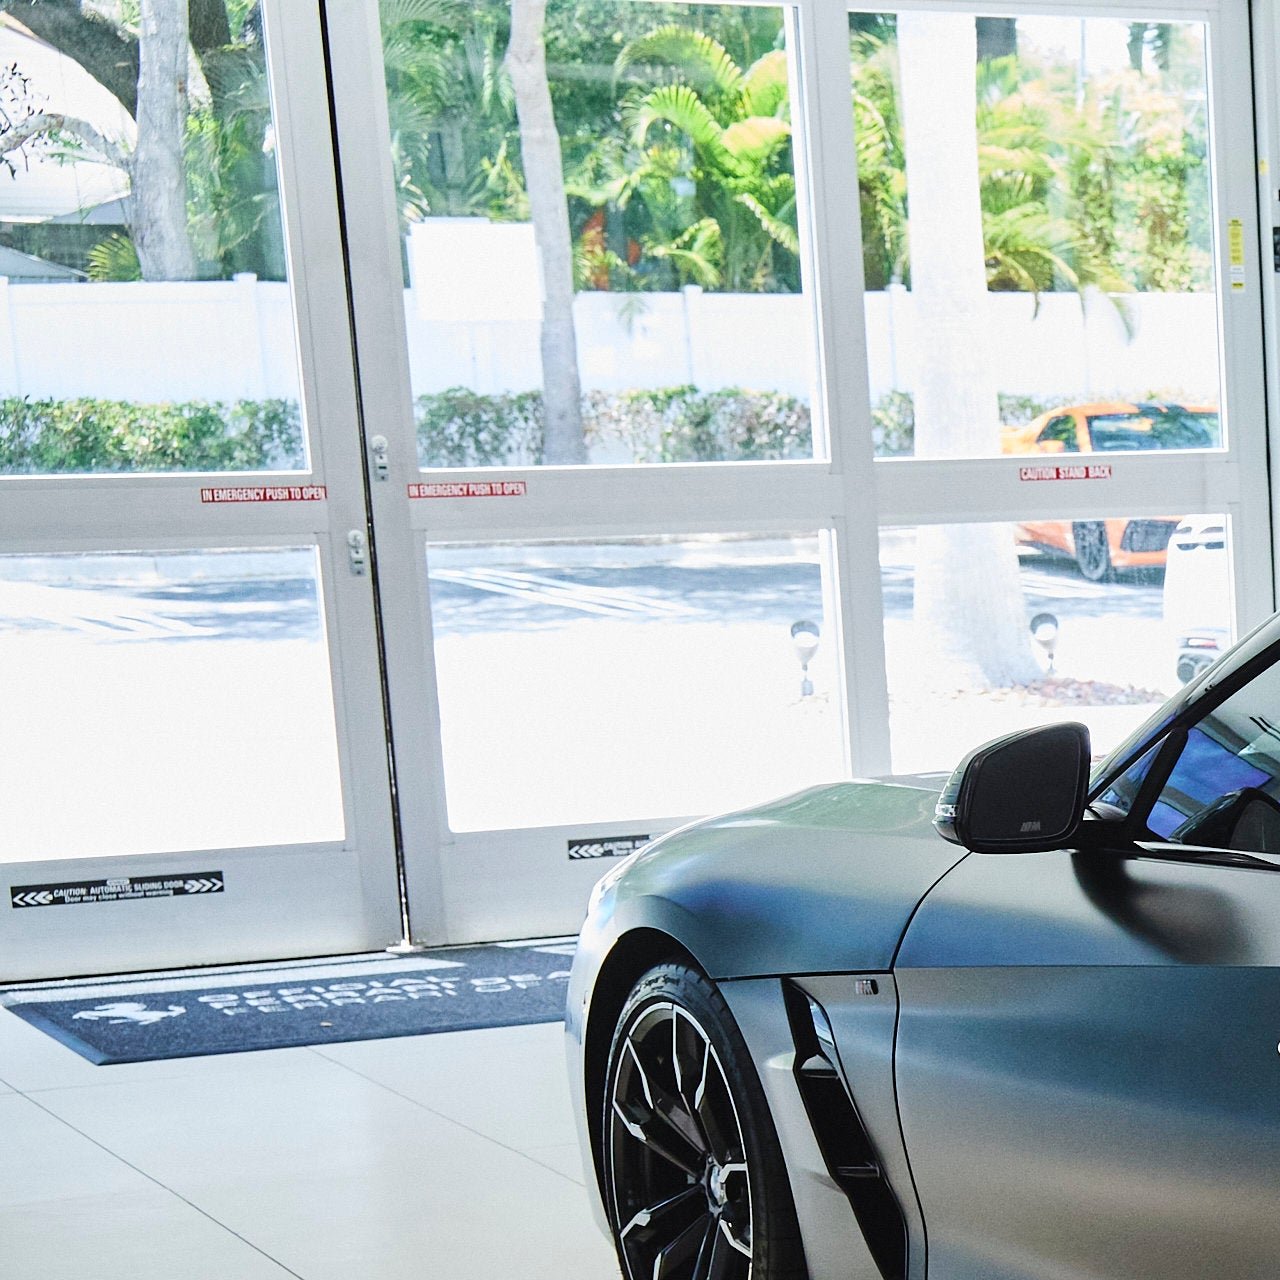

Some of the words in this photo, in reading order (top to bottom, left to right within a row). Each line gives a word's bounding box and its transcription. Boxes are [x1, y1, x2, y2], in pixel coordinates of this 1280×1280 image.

[1021, 468, 1056, 480] CAUTION
[1059, 467, 1085, 479] STAND
[1089, 466, 1111, 478] BACK
[202, 488, 213, 501] IN
[213, 488, 265, 501] EMERGENCY
[266, 487, 289, 500] PUSH
[289, 487, 301, 500] TO
[301, 486, 325, 500] OPEN
[408, 484, 418, 497] IN
[419, 484, 467, 497] EMERGENCY
[468, 483, 490, 496] PUSH
[491, 483, 502, 495] TO
[503, 482, 525, 495] OPEN
[90, 883, 132, 895] AUTOMATIC
[133, 881, 163, 892] SLIDING
[164, 879, 184, 890] DOOR
[197, 975, 461, 1002] OFFICIAL
[209, 982, 459, 1009] FERRARI
[222, 988, 458, 1016] FERRARI
